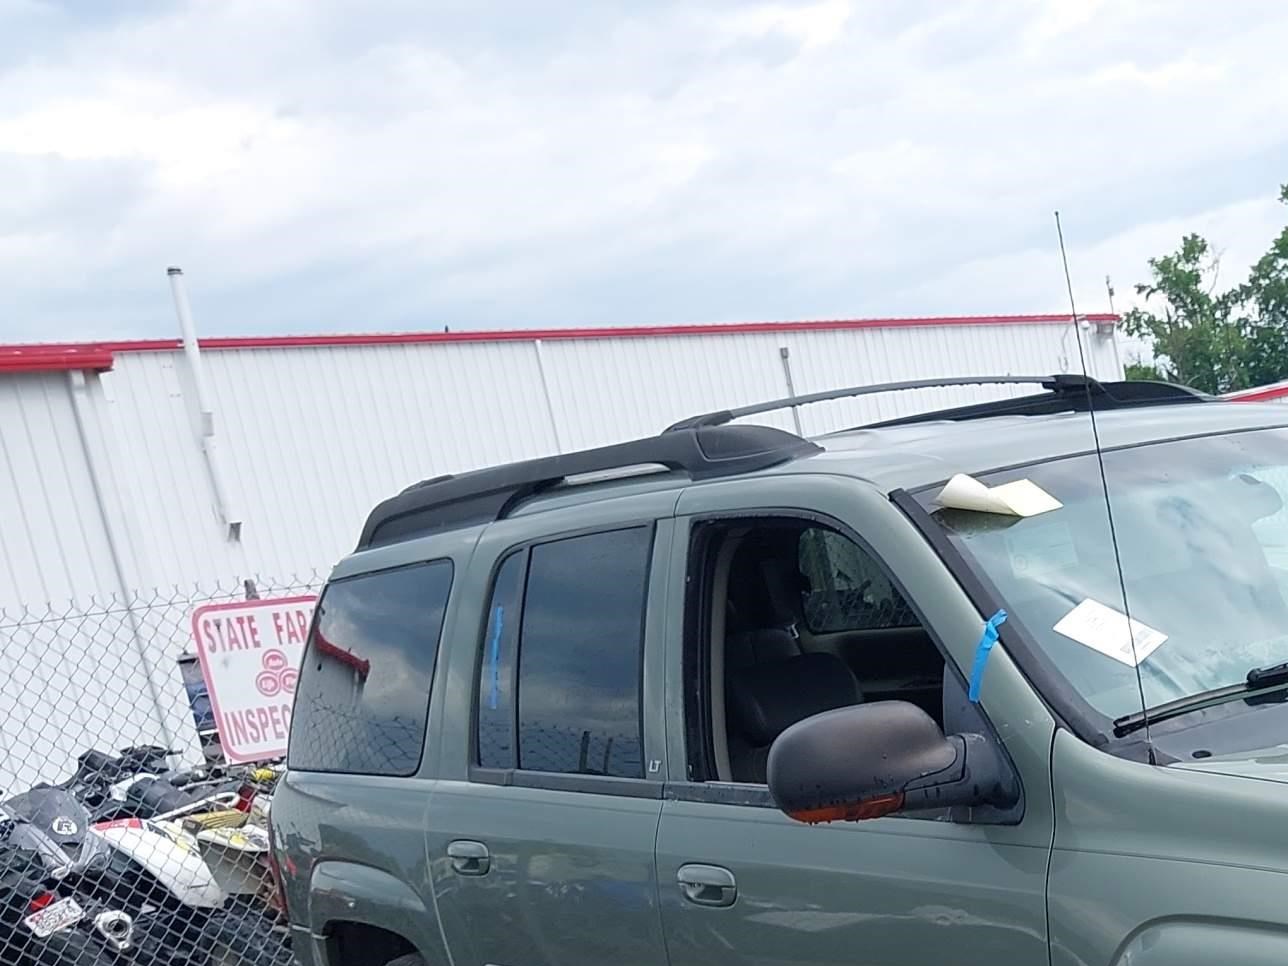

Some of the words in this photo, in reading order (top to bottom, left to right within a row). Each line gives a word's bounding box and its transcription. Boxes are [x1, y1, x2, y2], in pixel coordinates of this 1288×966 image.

[203, 615, 262, 654] STATE
[272, 609, 314, 646] FAR
[649, 760, 662, 773] LT
